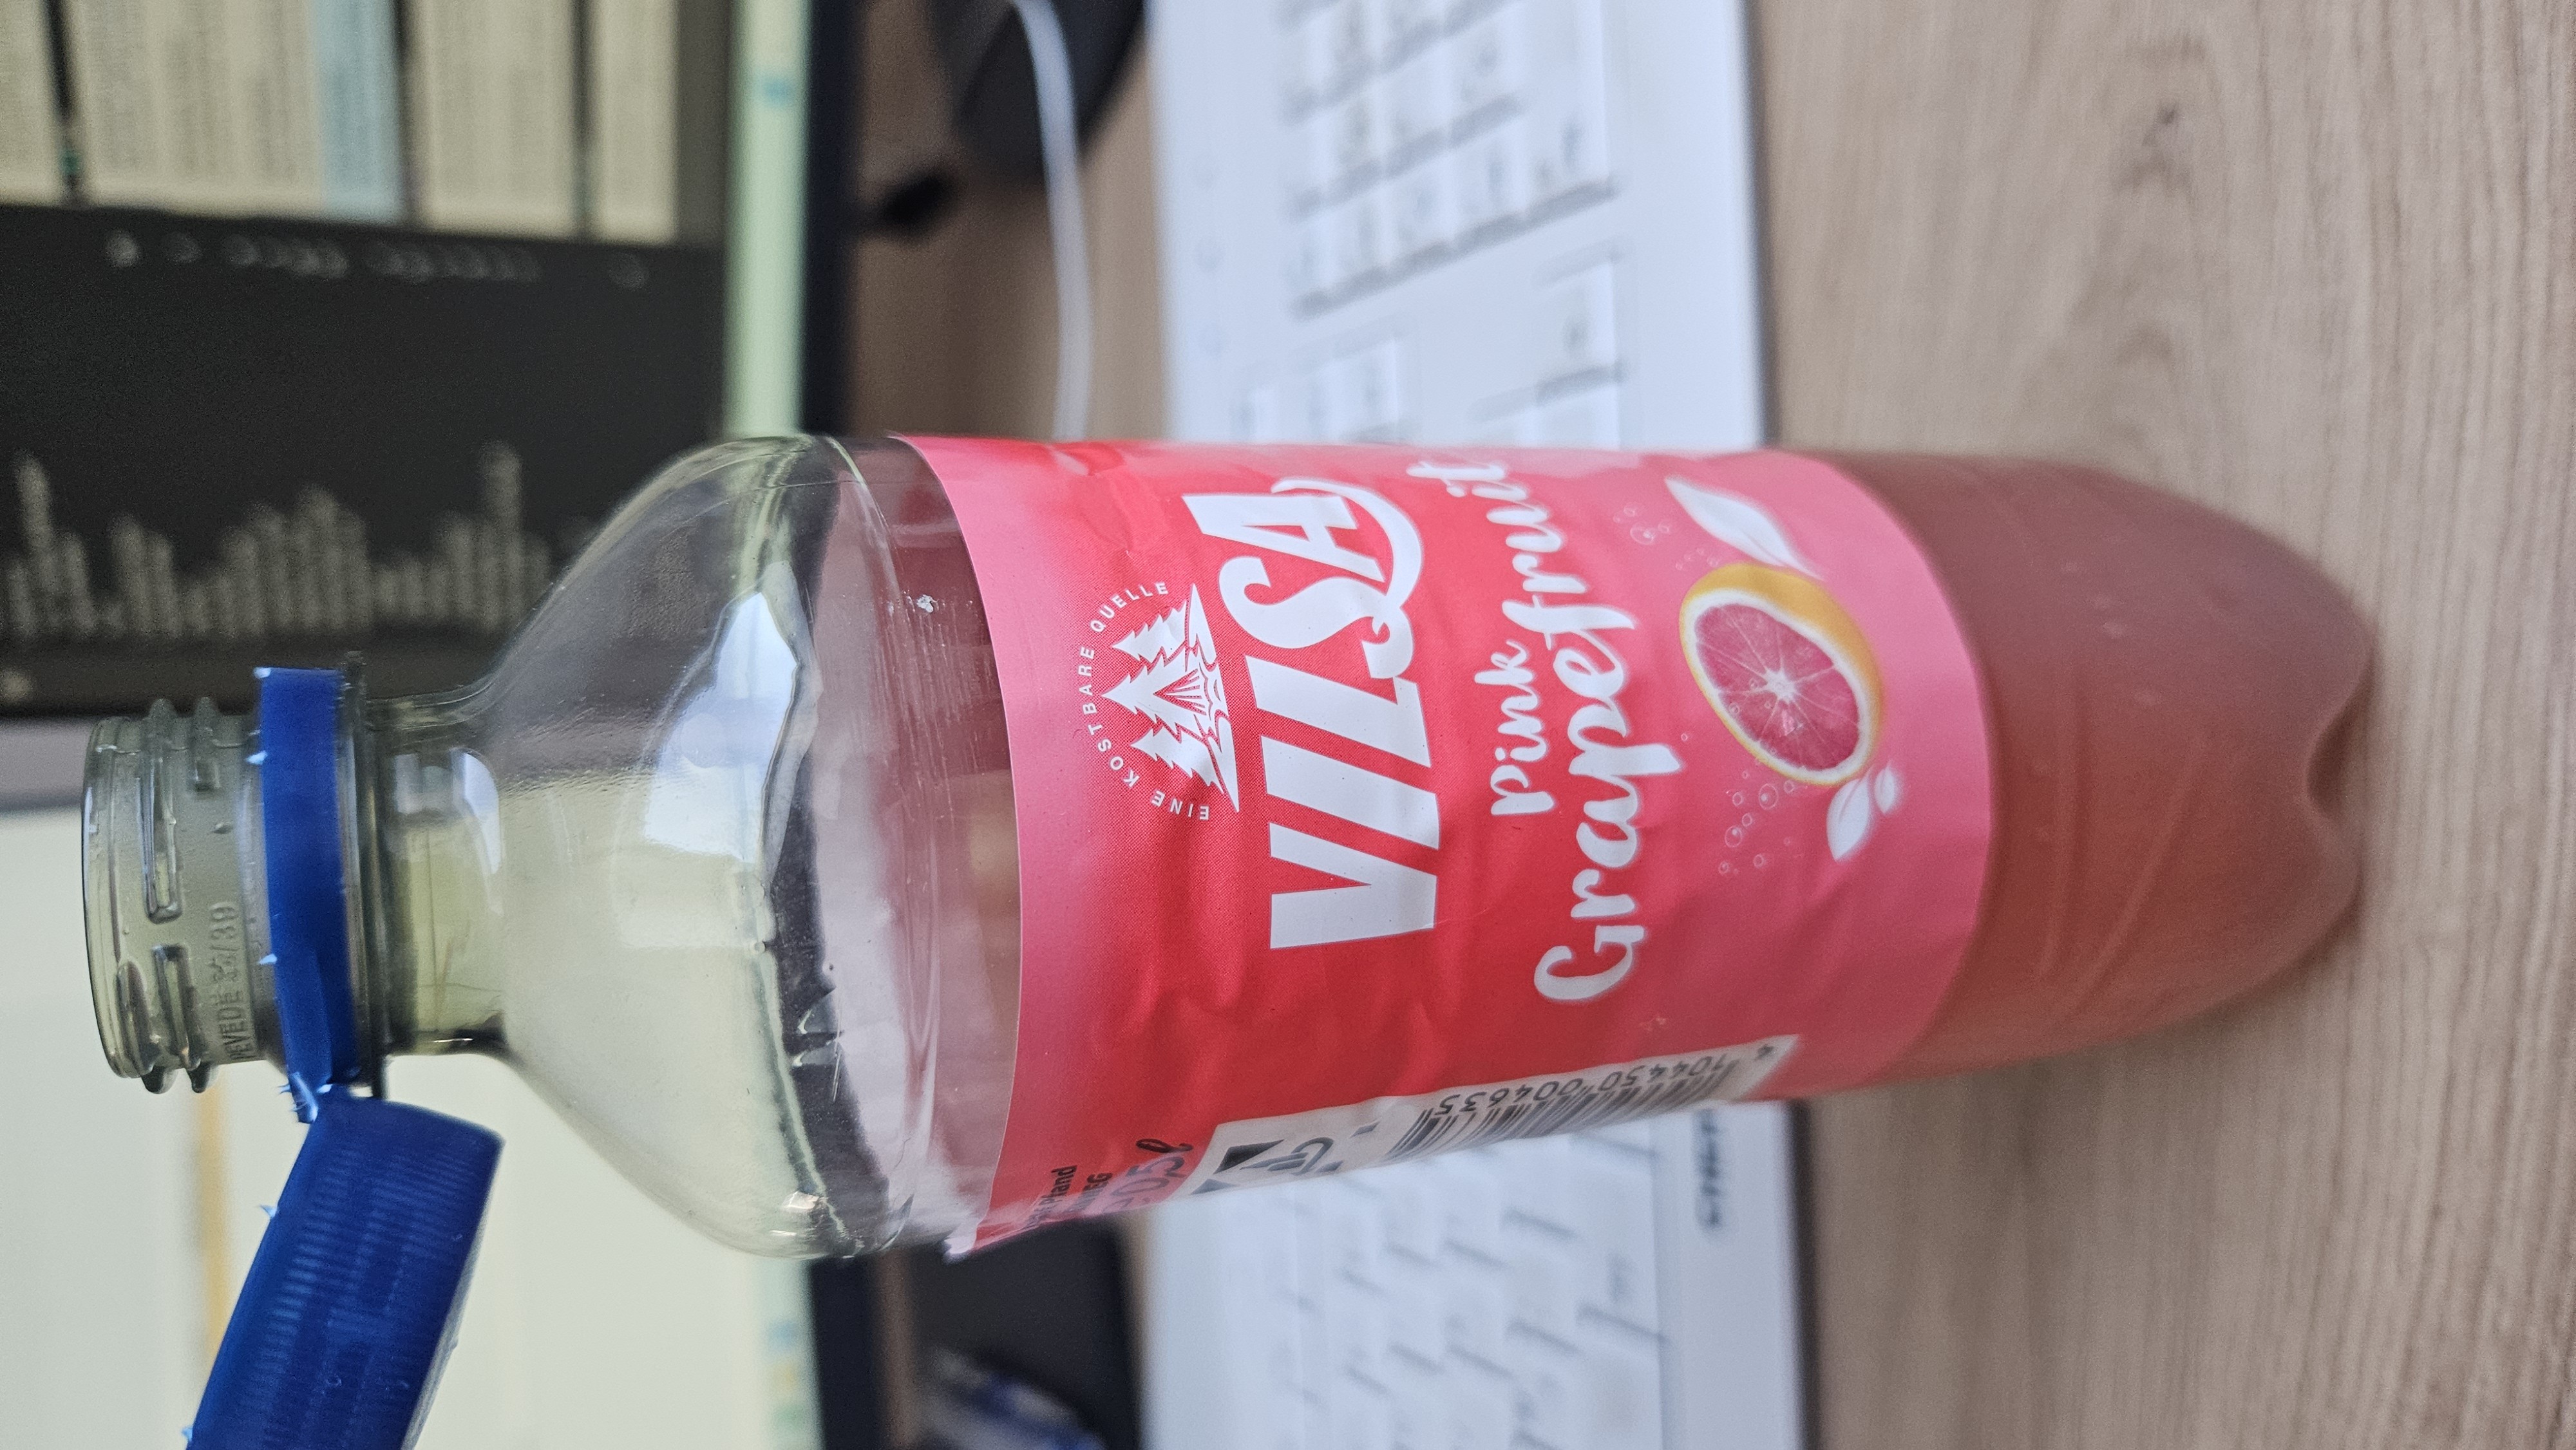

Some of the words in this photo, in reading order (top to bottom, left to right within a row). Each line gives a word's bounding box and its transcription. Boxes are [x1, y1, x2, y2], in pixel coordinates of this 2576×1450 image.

[1090, 581, 1168, 633] QUELLE
[1077, 645, 1140, 787] KOSTBARE
[1182, 478, 1440, 949] VILSA
[1406, 460, 1680, 1002] Grapefruit
[1151, 789, 1209, 820] EINE
[1434, 1078, 1583, 1115] 004635
